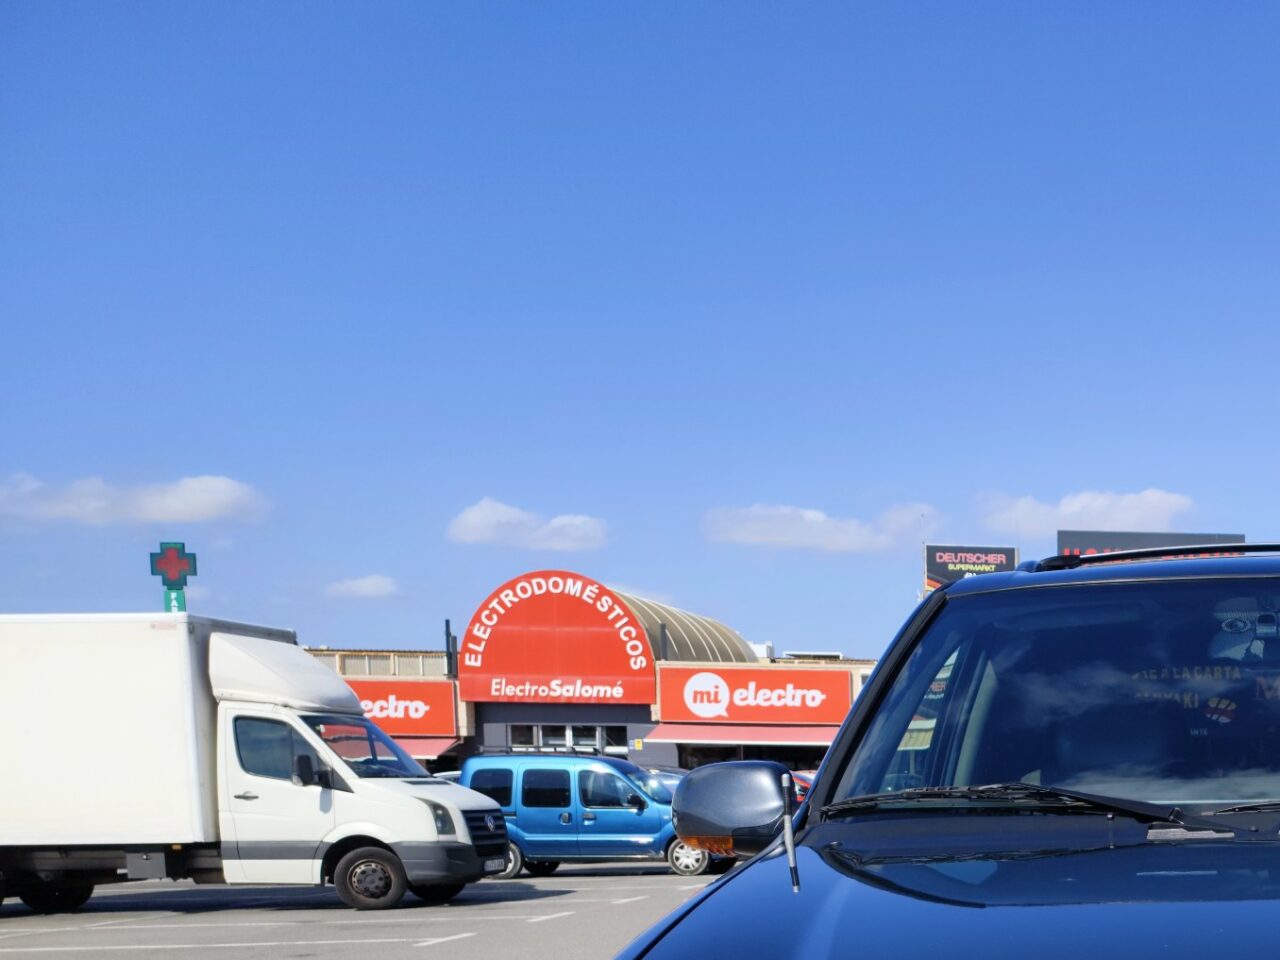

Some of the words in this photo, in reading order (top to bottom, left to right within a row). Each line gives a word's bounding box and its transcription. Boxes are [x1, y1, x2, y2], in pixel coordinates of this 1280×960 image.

[936, 552, 1006, 564] DEUTSCHER
[948, 563, 996, 572] SUPERMARKT
[465, 577, 647, 670] ELECTRODOMÉSTICOS
[491, 678, 624, 698] ElectroSalomé
[692, 685, 722, 704] mi
[733, 681, 826, 707] electro
